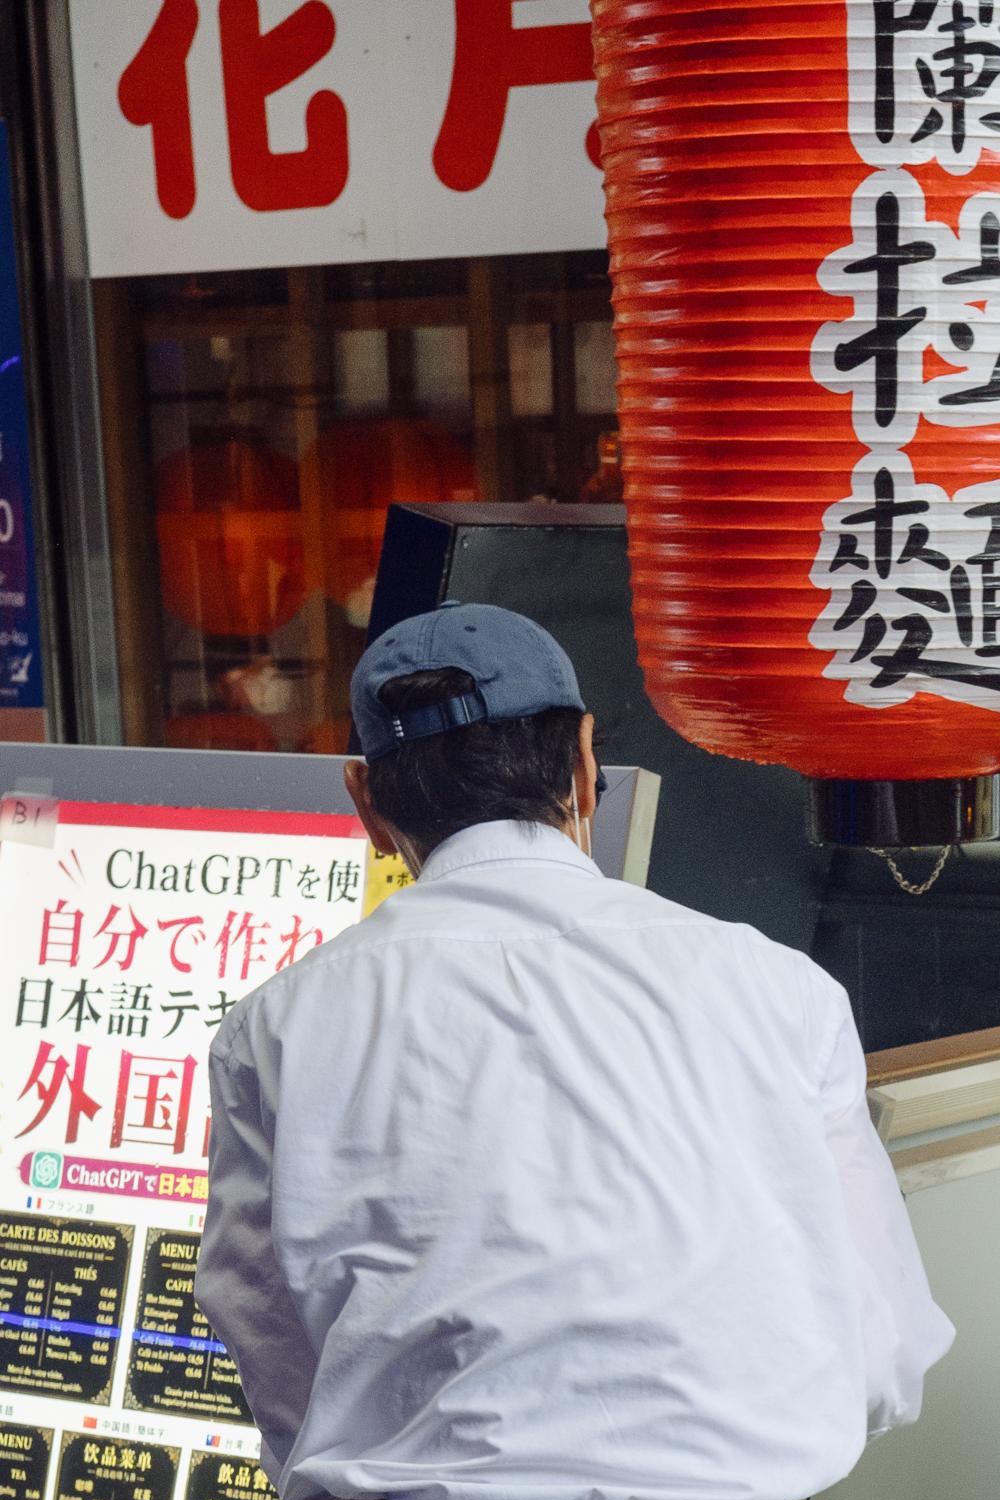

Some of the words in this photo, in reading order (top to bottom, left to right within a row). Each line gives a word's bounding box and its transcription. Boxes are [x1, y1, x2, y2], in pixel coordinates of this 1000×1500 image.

[12, 801, 40, 826] B1
[106, 848, 361, 903] ChatGPTを使
[14, 1040, 211, 1156] 外国
[0, 1222, 36, 1242] CARTE
[37, 1227, 60, 1244] DES
[61, 1230, 117, 1252] BOISSONS
[159, 1241, 195, 1260] MENU
[0, 1432, 33, 1450] MENU
